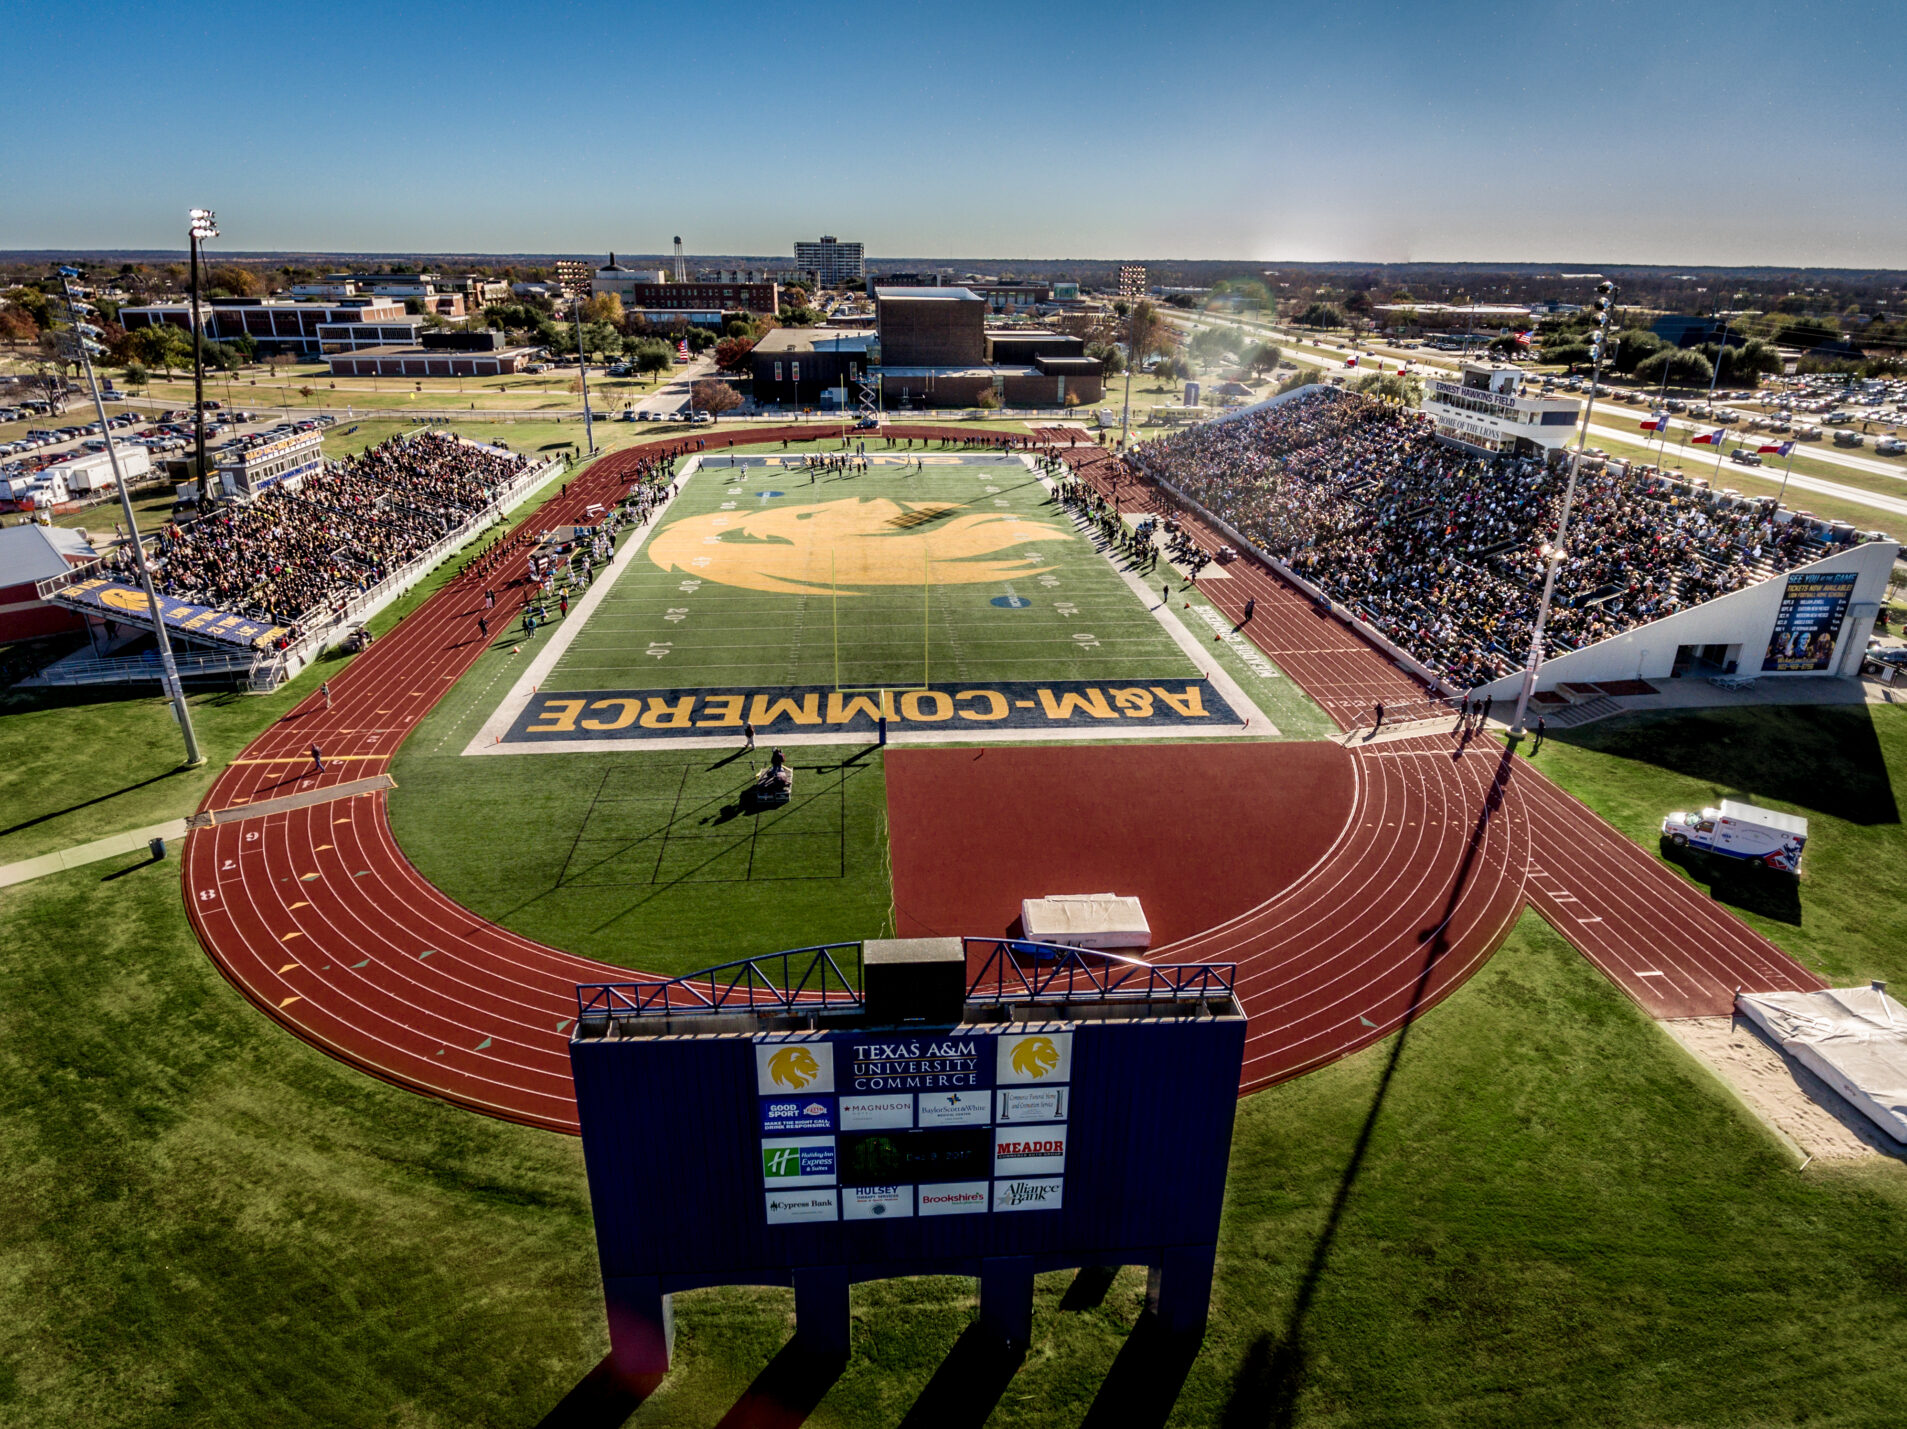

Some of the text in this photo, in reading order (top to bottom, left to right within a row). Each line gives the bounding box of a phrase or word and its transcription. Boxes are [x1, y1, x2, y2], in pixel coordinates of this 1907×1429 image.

[1436, 382, 1516, 408] ERNEST HAWKINS FIELD
[1438, 415, 1500, 439] HOME OF THE LIONS
[763, 456, 963, 466] LNS
[664, 607, 689, 620] 20
[1053, 602, 1080, 614] 20
[1072, 633, 1100, 647] 10
[645, 641, 674, 656] 10
[526, 686, 1210, 733] A&M-COMMERCE
[200, 889, 216, 901] 8
[853, 1041, 977, 1060] TEXAS A&M
[854, 1059, 977, 1075] UNIVERSITY
[855, 1074, 977, 1090] COMMERCE
[768, 1110, 800, 1118] SPORT
[769, 1103, 797, 1112] GOOD
[852, 1103, 911, 1112] MAGNUSON
[997, 1140, 1064, 1154] MEADOR
[801, 1158, 833, 1167] Express
[856, 1186, 899, 1196] HULSEY
[1004, 1182, 1061, 1195] Alliance
[777, 1199, 833, 1209] Cypress Bank
[922, 1191, 984, 1204] Brookshire's
[1010, 1191, 1047, 1206] Bank
